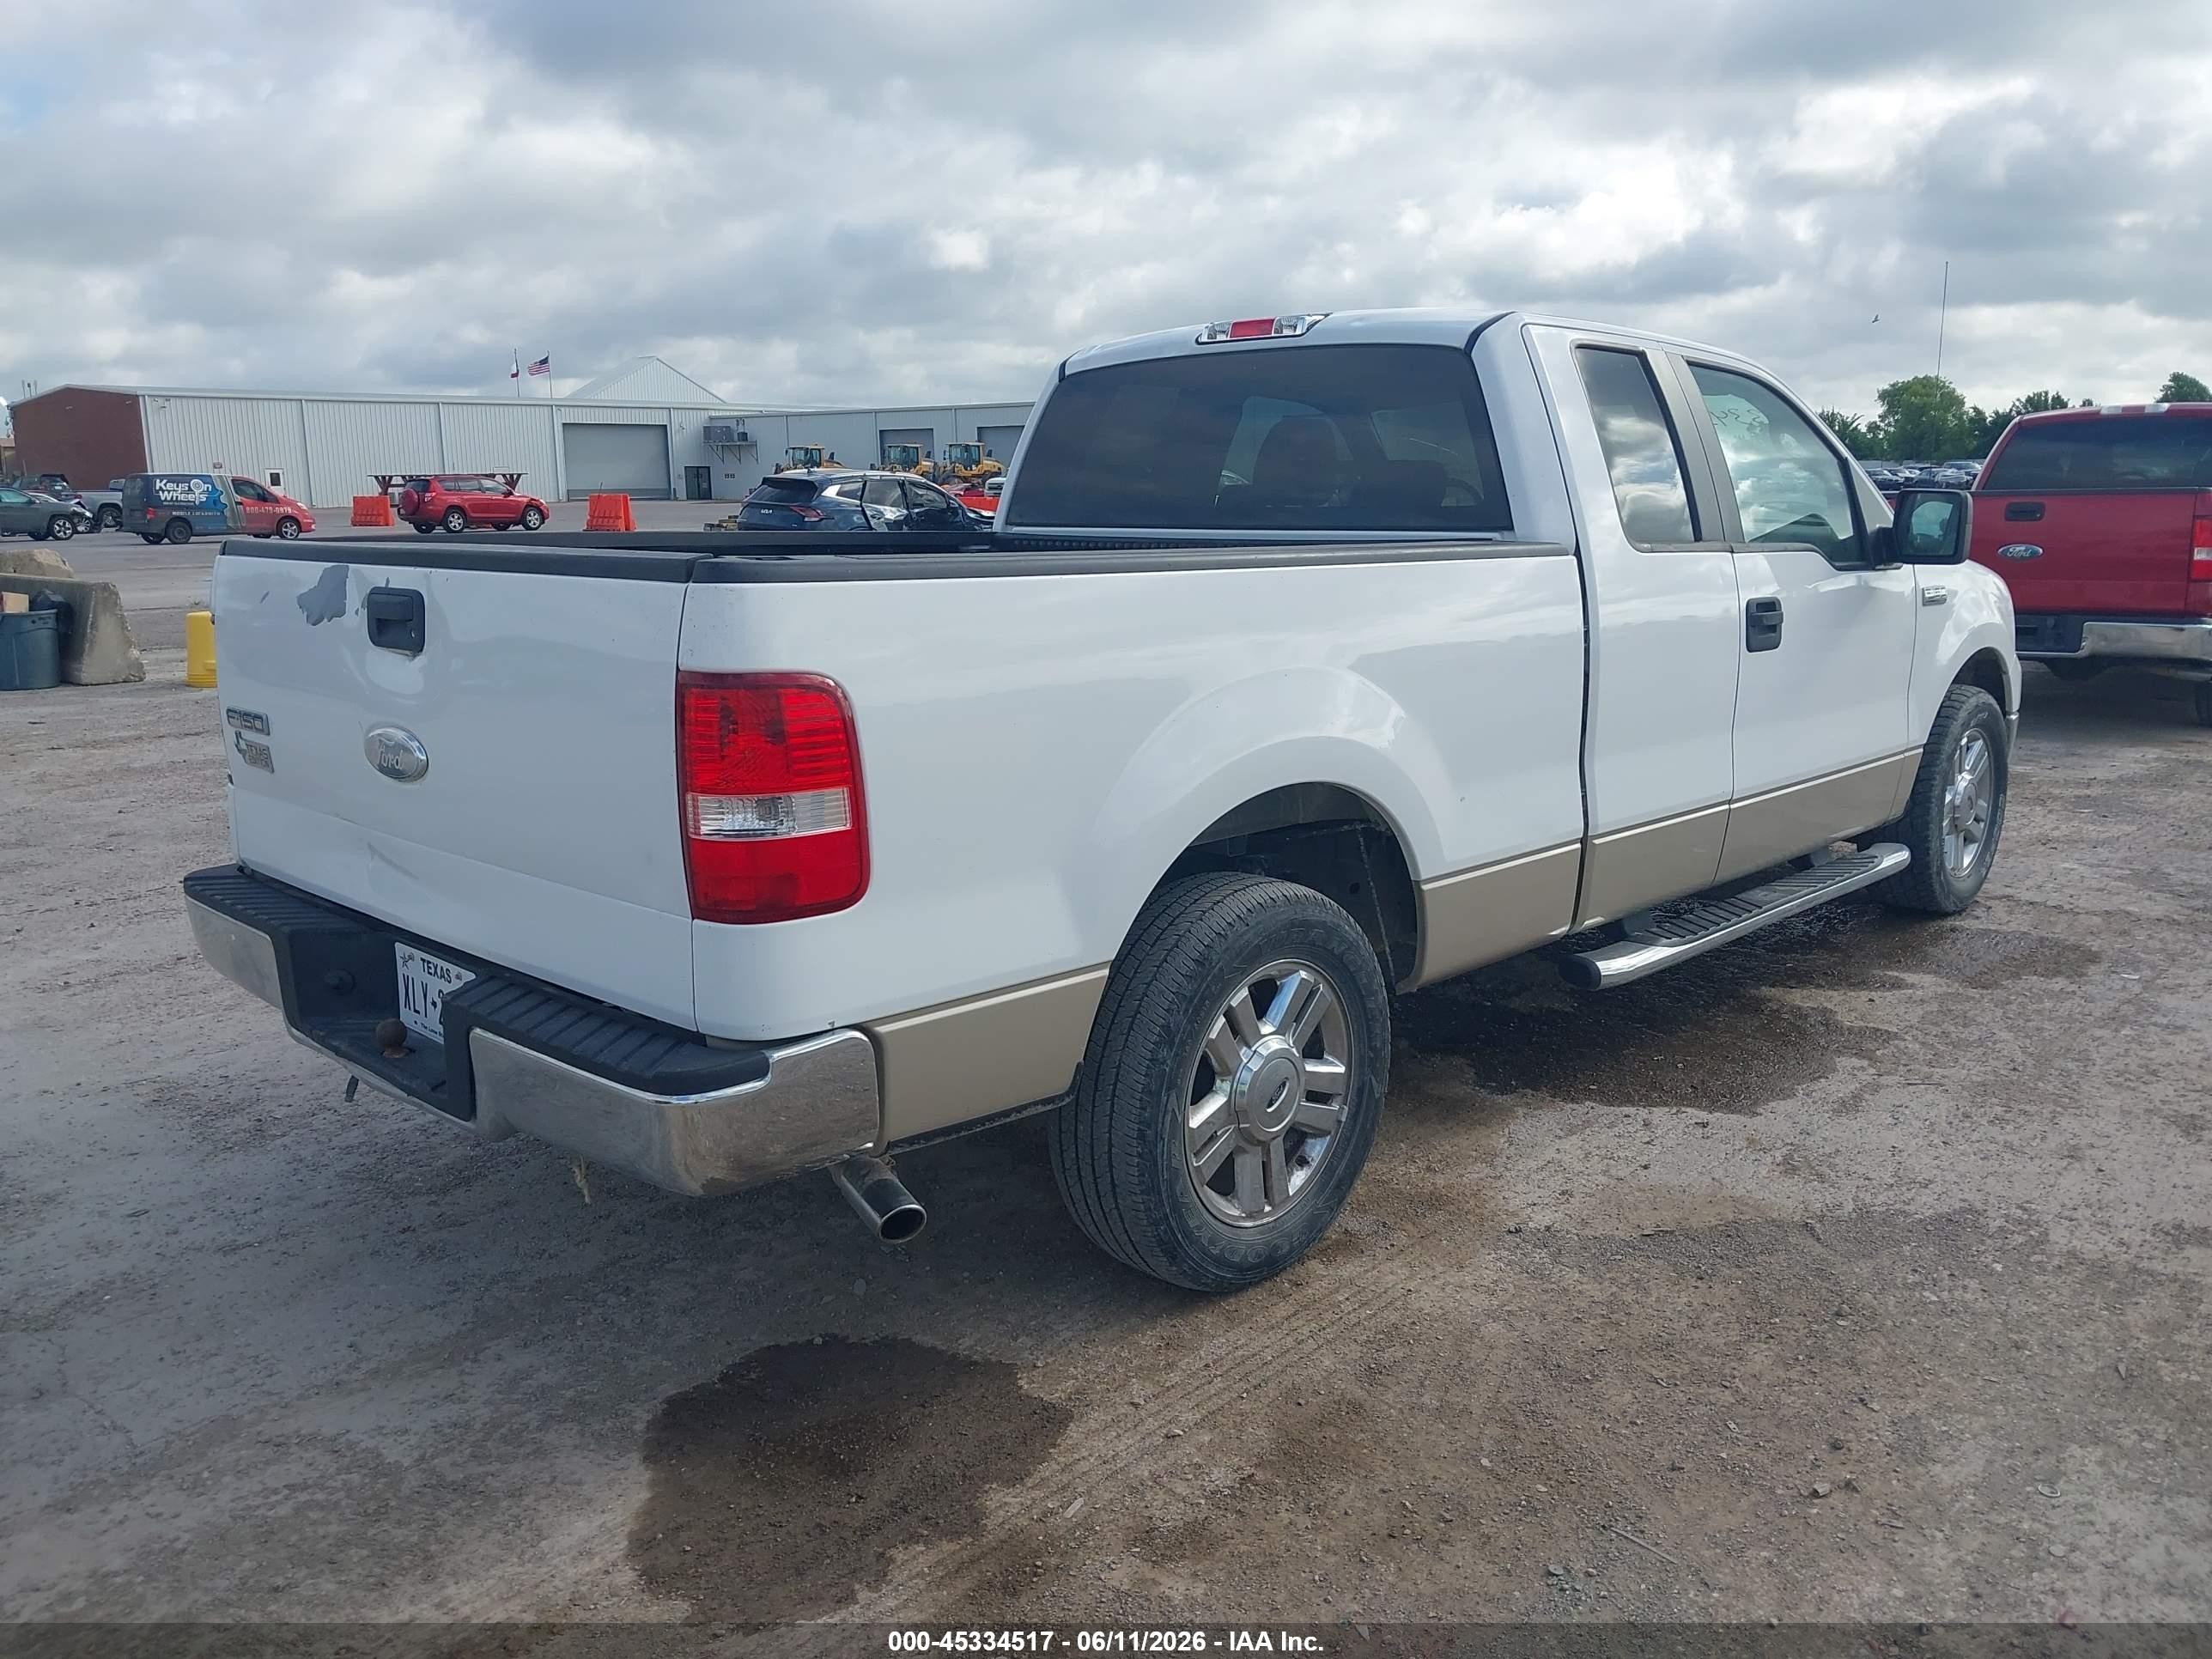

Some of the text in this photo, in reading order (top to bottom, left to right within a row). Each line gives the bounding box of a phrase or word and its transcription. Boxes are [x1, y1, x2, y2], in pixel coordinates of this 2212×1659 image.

[155, 479, 189, 493] Keys
[159, 490, 207, 503] Wheels
[2007, 547, 2031, 556] Ford
[378, 738, 405, 770] Ford
[420, 957, 452, 984] TEXAS
